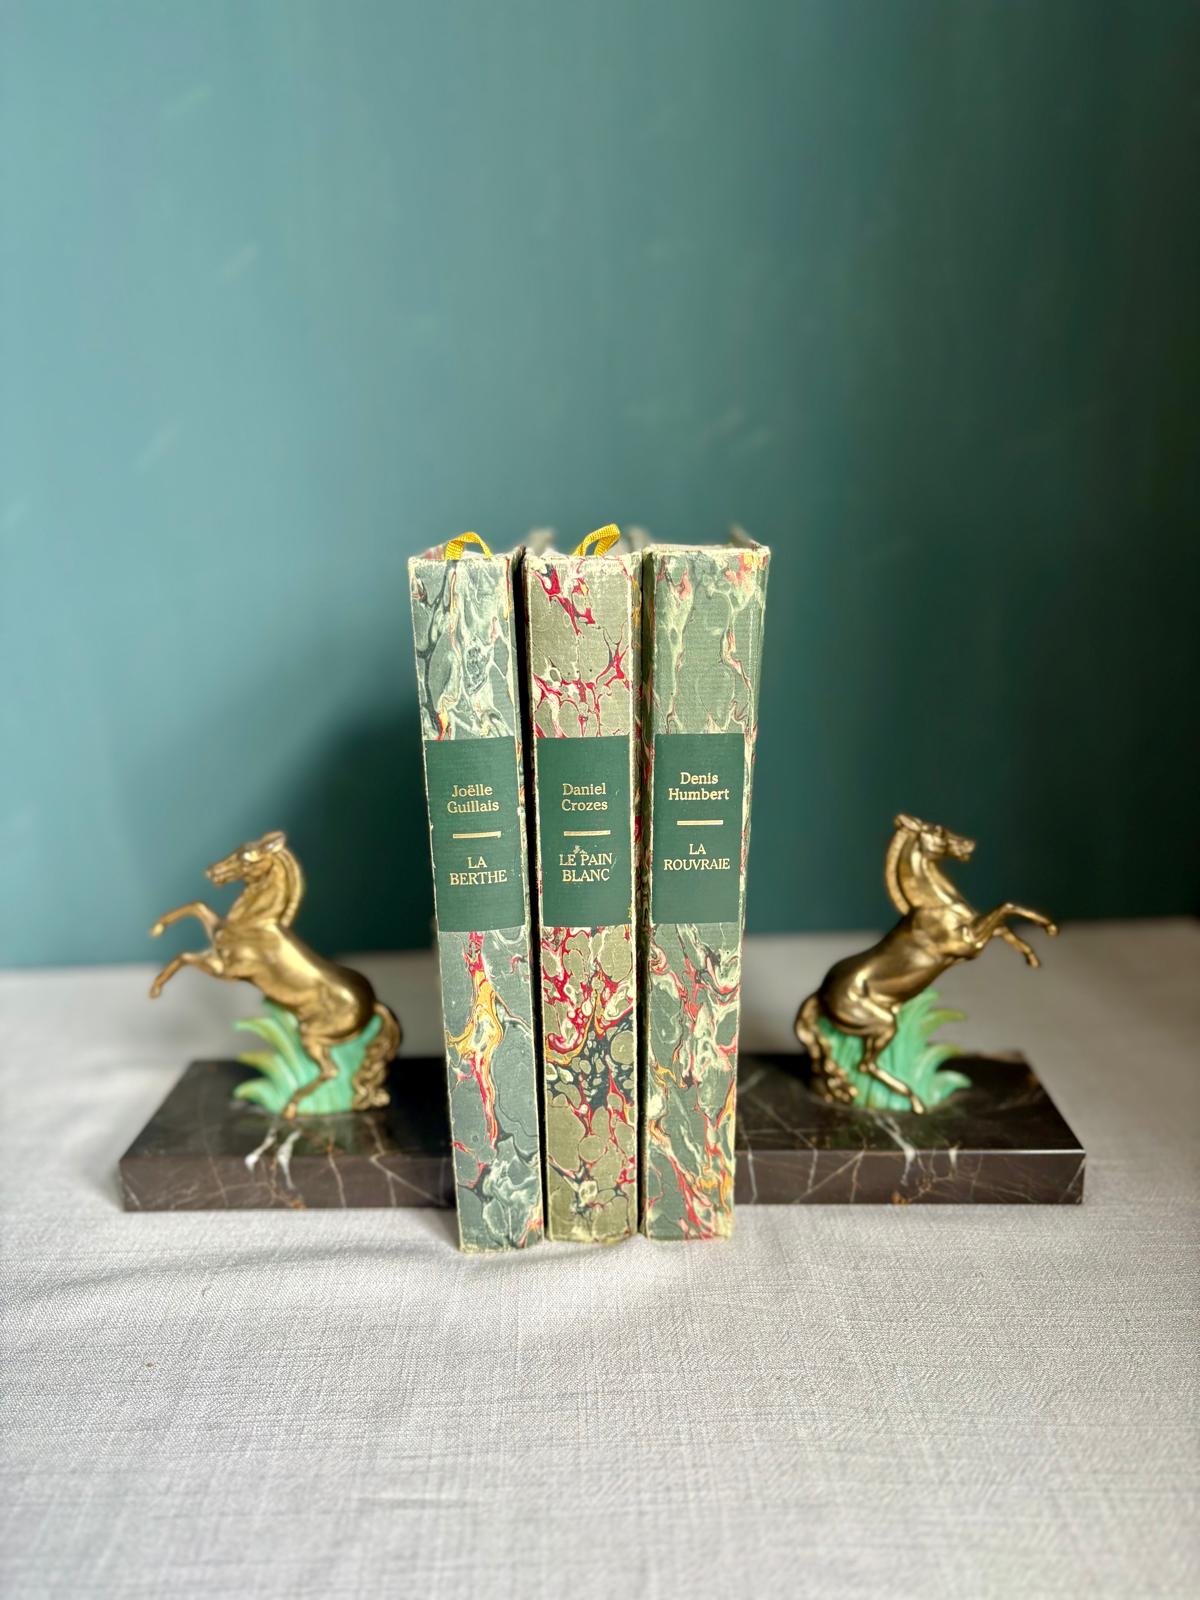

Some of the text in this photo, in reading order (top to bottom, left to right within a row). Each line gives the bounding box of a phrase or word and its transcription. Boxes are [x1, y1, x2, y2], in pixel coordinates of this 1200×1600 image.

[680, 772, 719, 785] Denis
[452, 784, 493, 797] Joëlle
[562, 783, 607, 796] Daniel
[668, 788, 730, 801] Humbert
[447, 800, 500, 813] Guillais
[561, 799, 608, 811] Crozes
[689, 843, 707, 855] LA
[467, 856, 488, 869] LA
[559, 852, 613, 866] LE PAIN
[663, 858, 731, 871] ROUVRAIE
[449, 869, 508, 886] BERTHE
[562, 868, 610, 882] BLANC
